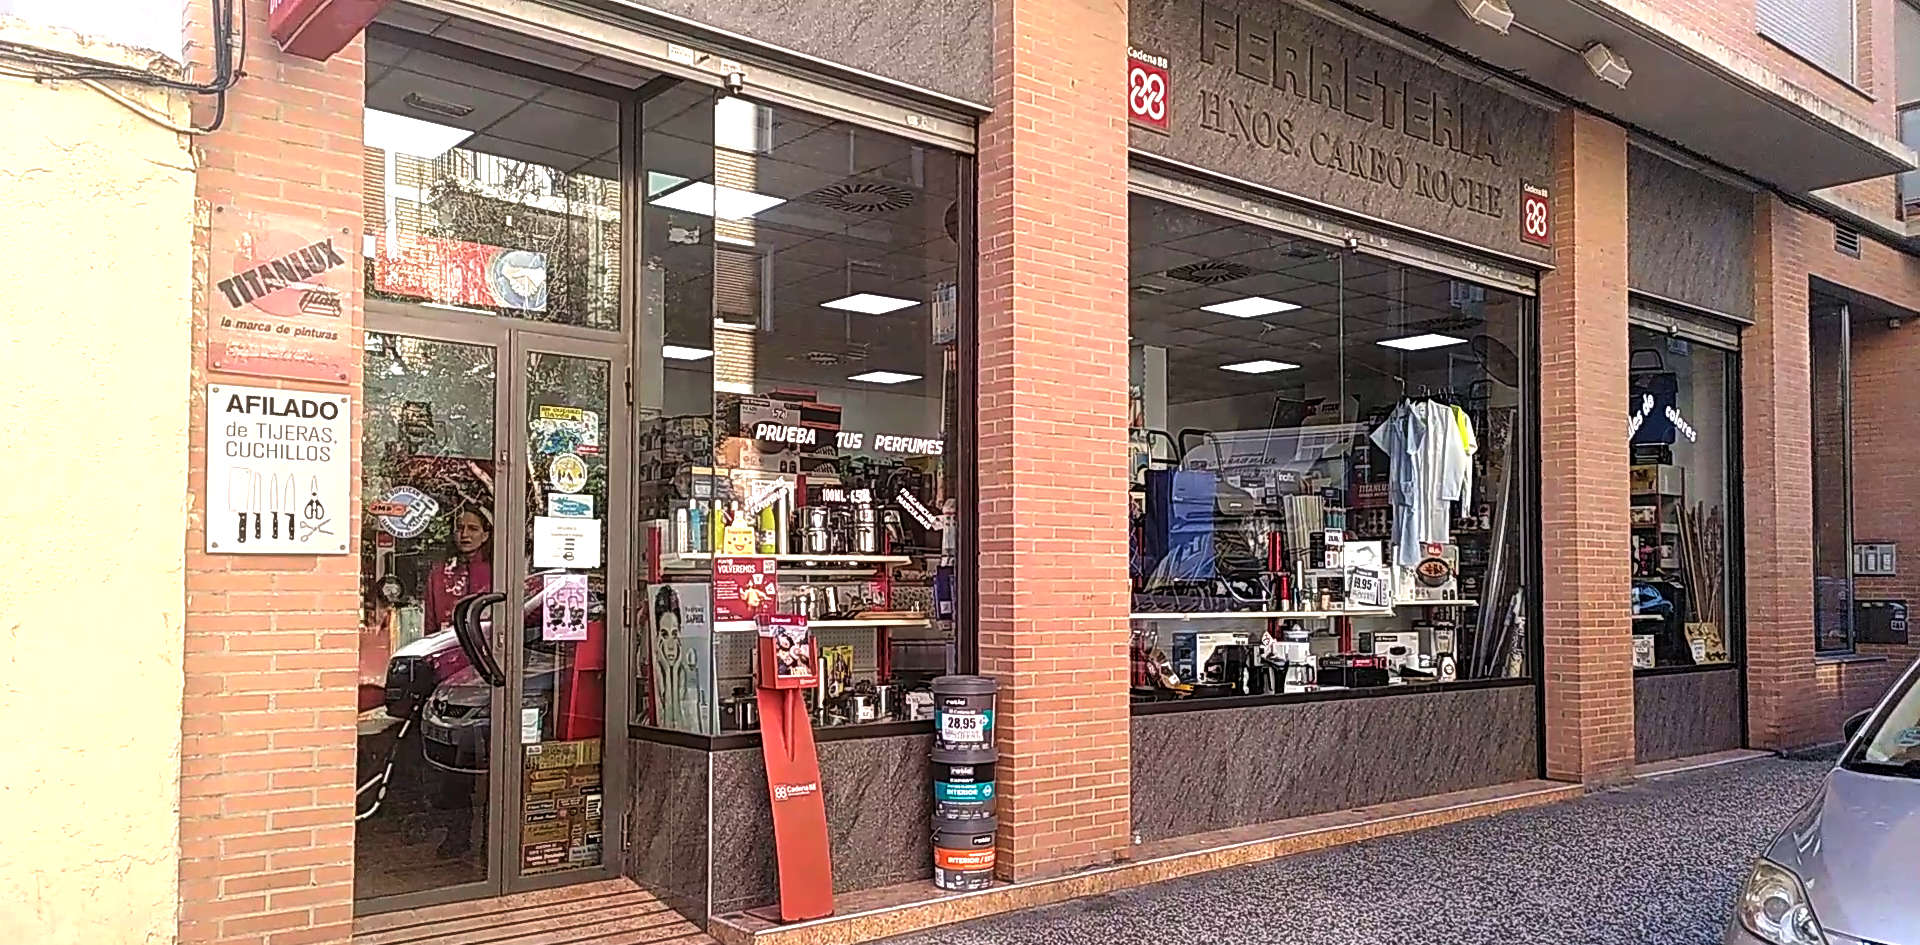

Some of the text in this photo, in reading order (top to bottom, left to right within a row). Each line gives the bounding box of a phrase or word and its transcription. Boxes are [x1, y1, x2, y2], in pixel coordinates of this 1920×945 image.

[1128, 46, 1168, 69] Cadena 88
[1201, 0, 1502, 168] FERRETERIA
[1200, 90, 1502, 218] HNOS. CARBÓ ROCHE
[217, 238, 344, 308] TITANLUX
[221, 316, 338, 341] la marca de pinturas
[226, 394, 339, 420] AFILADO
[1642, 394, 1654, 416] de
[1665, 405, 1696, 442] colores
[226, 421, 337, 444] de TIJERAS,
[756, 423, 944, 455] PRUEBA TUS PERFUMES
[226, 440, 331, 462] CUCHILLOS
[717, 564, 756, 574] VOLVEREMOS
